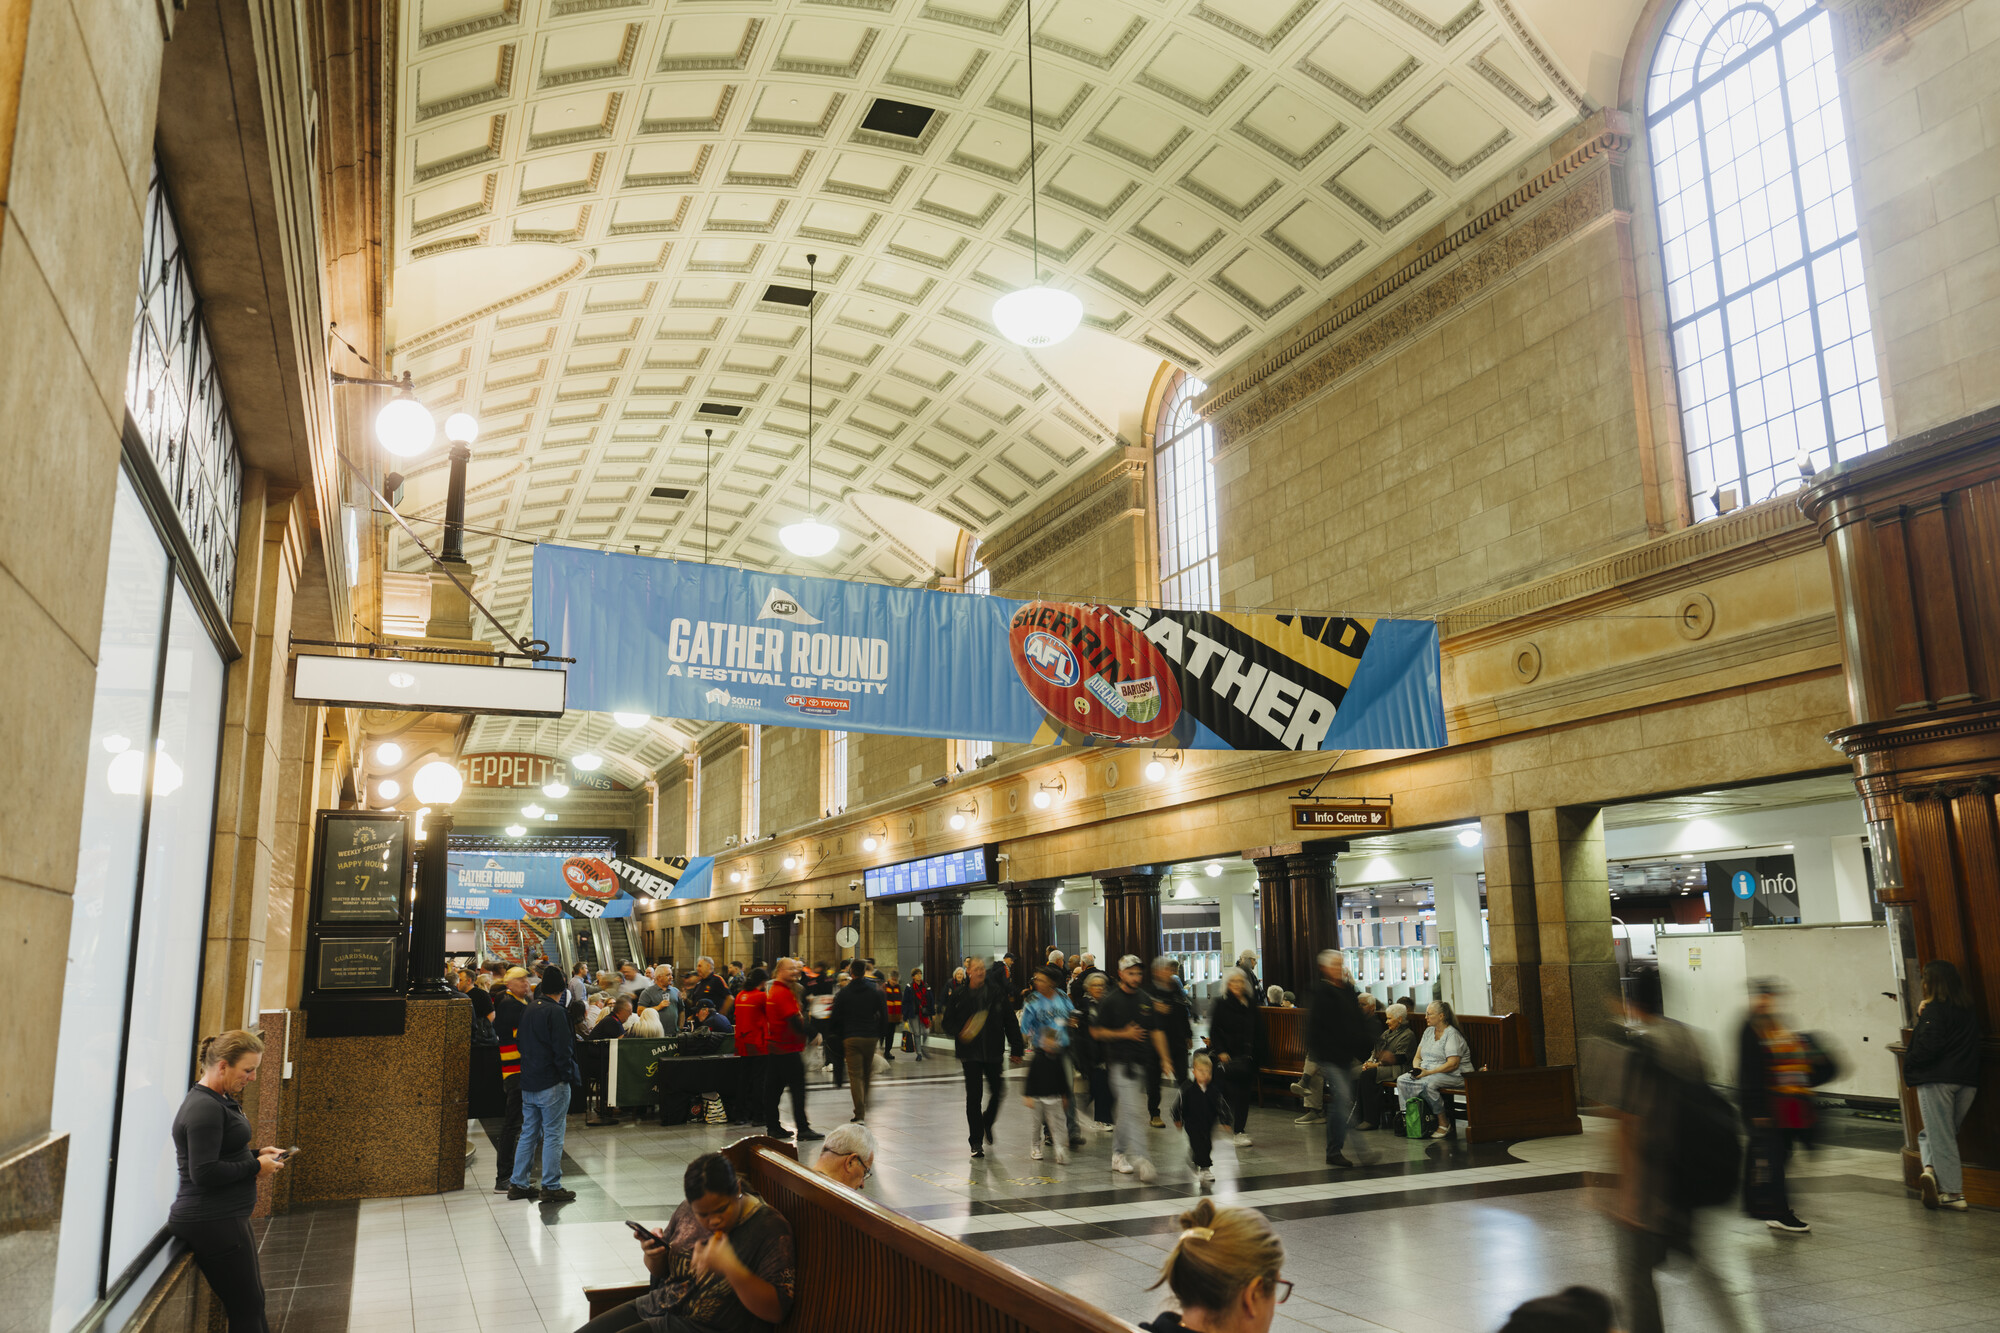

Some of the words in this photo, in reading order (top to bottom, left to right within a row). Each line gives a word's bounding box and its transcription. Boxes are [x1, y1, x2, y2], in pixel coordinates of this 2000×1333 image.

[773, 603, 797, 613] AFL
[667, 617, 785, 673] GATHER
[790, 630, 889, 681] ROUND
[1026, 637, 1072, 685] AFL
[666, 664, 682, 677] A
[687, 666, 786, 687] FESTIVAL
[790, 676, 818, 689] OF
[821, 678, 888, 695] FOOTY
[1087, 675, 1127, 715] ADELAIDE
[1120, 681, 1155, 698] BAROSSA
[731, 696, 761, 707] SOUTH
[785, 695, 806, 705] AFL
[820, 700, 848, 709] TOYOTA
[574, 770, 611, 790] WINES
[1314, 812, 1334, 823] Info
[1336, 812, 1368, 823] Centre
[337, 848, 362, 857] WEEKLY
[362, 842, 391, 853] SPECIALS
[337, 860, 363, 870] HAPPY
[354, 874, 370, 891] $7
[458, 869, 493, 884] GATHER
[493, 870, 525, 884] ROUND
[1760, 872, 1796, 895] info
[334, 953, 379, 963] GUARDSMAN
[651, 1045, 667, 1056] BAR
